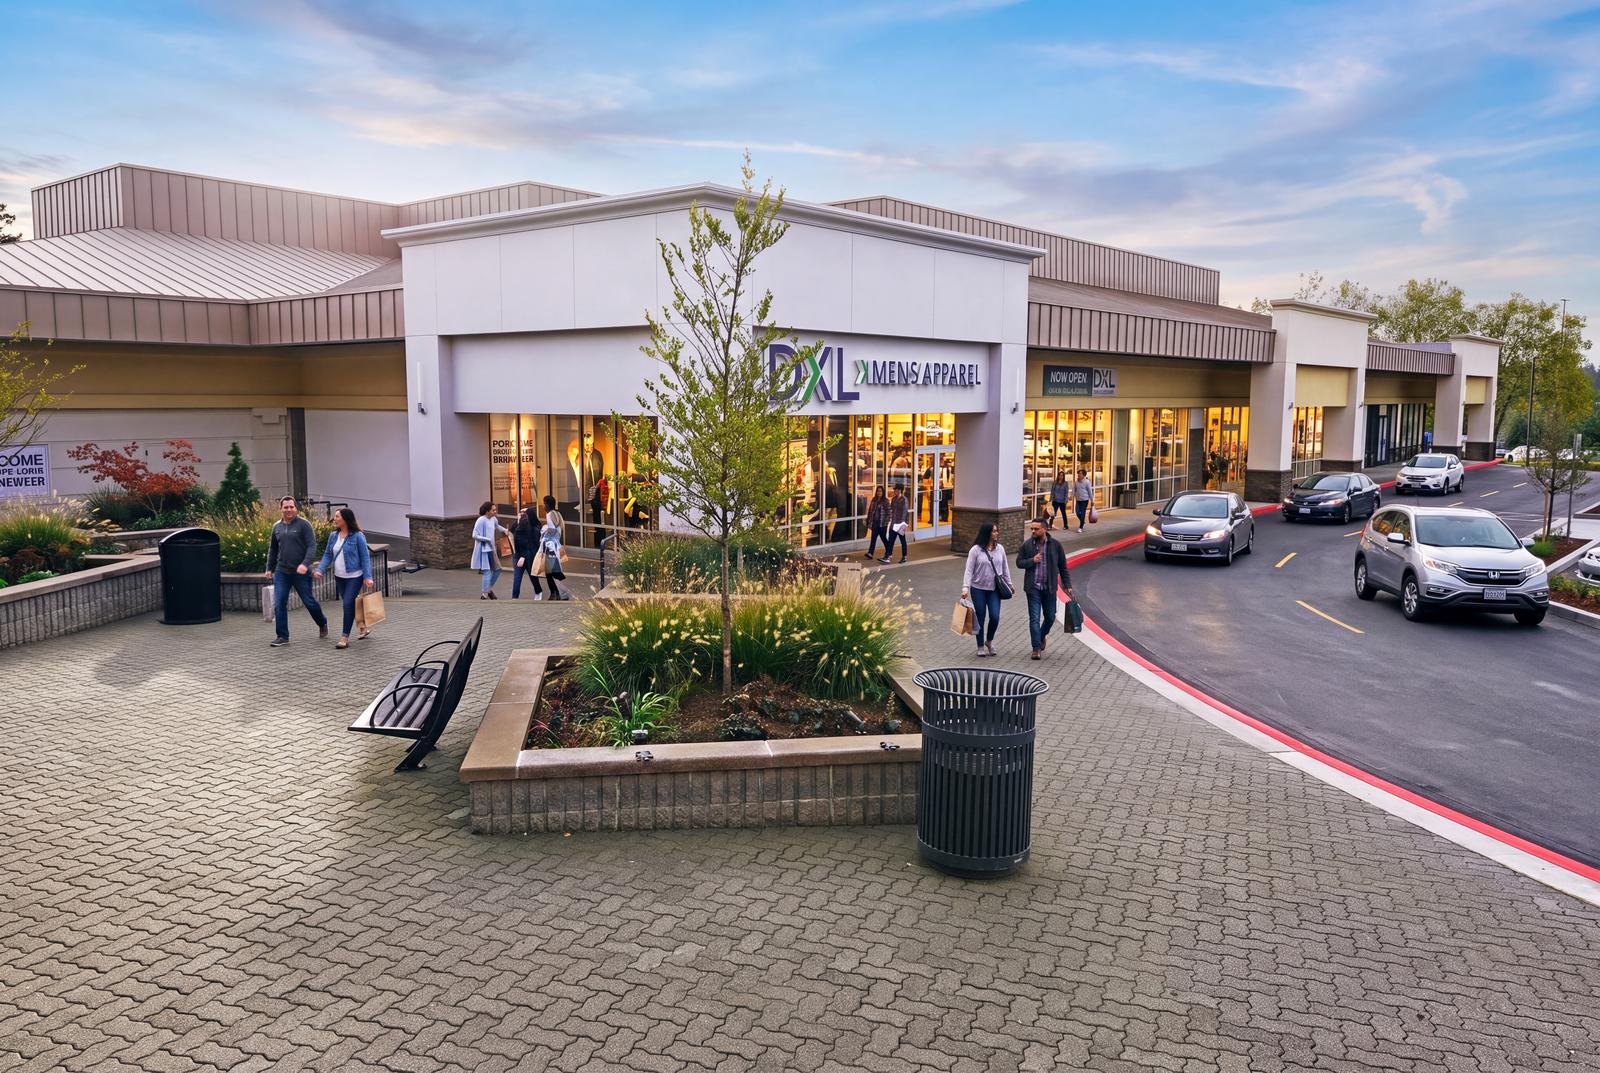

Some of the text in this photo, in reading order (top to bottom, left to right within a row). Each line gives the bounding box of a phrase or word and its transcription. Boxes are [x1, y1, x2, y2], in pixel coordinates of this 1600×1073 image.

[769, 343, 982, 401] DXL MENS APPAREL
[1050, 371, 1088, 384] NOW OPEN
[1094, 369, 1116, 388] DXL
